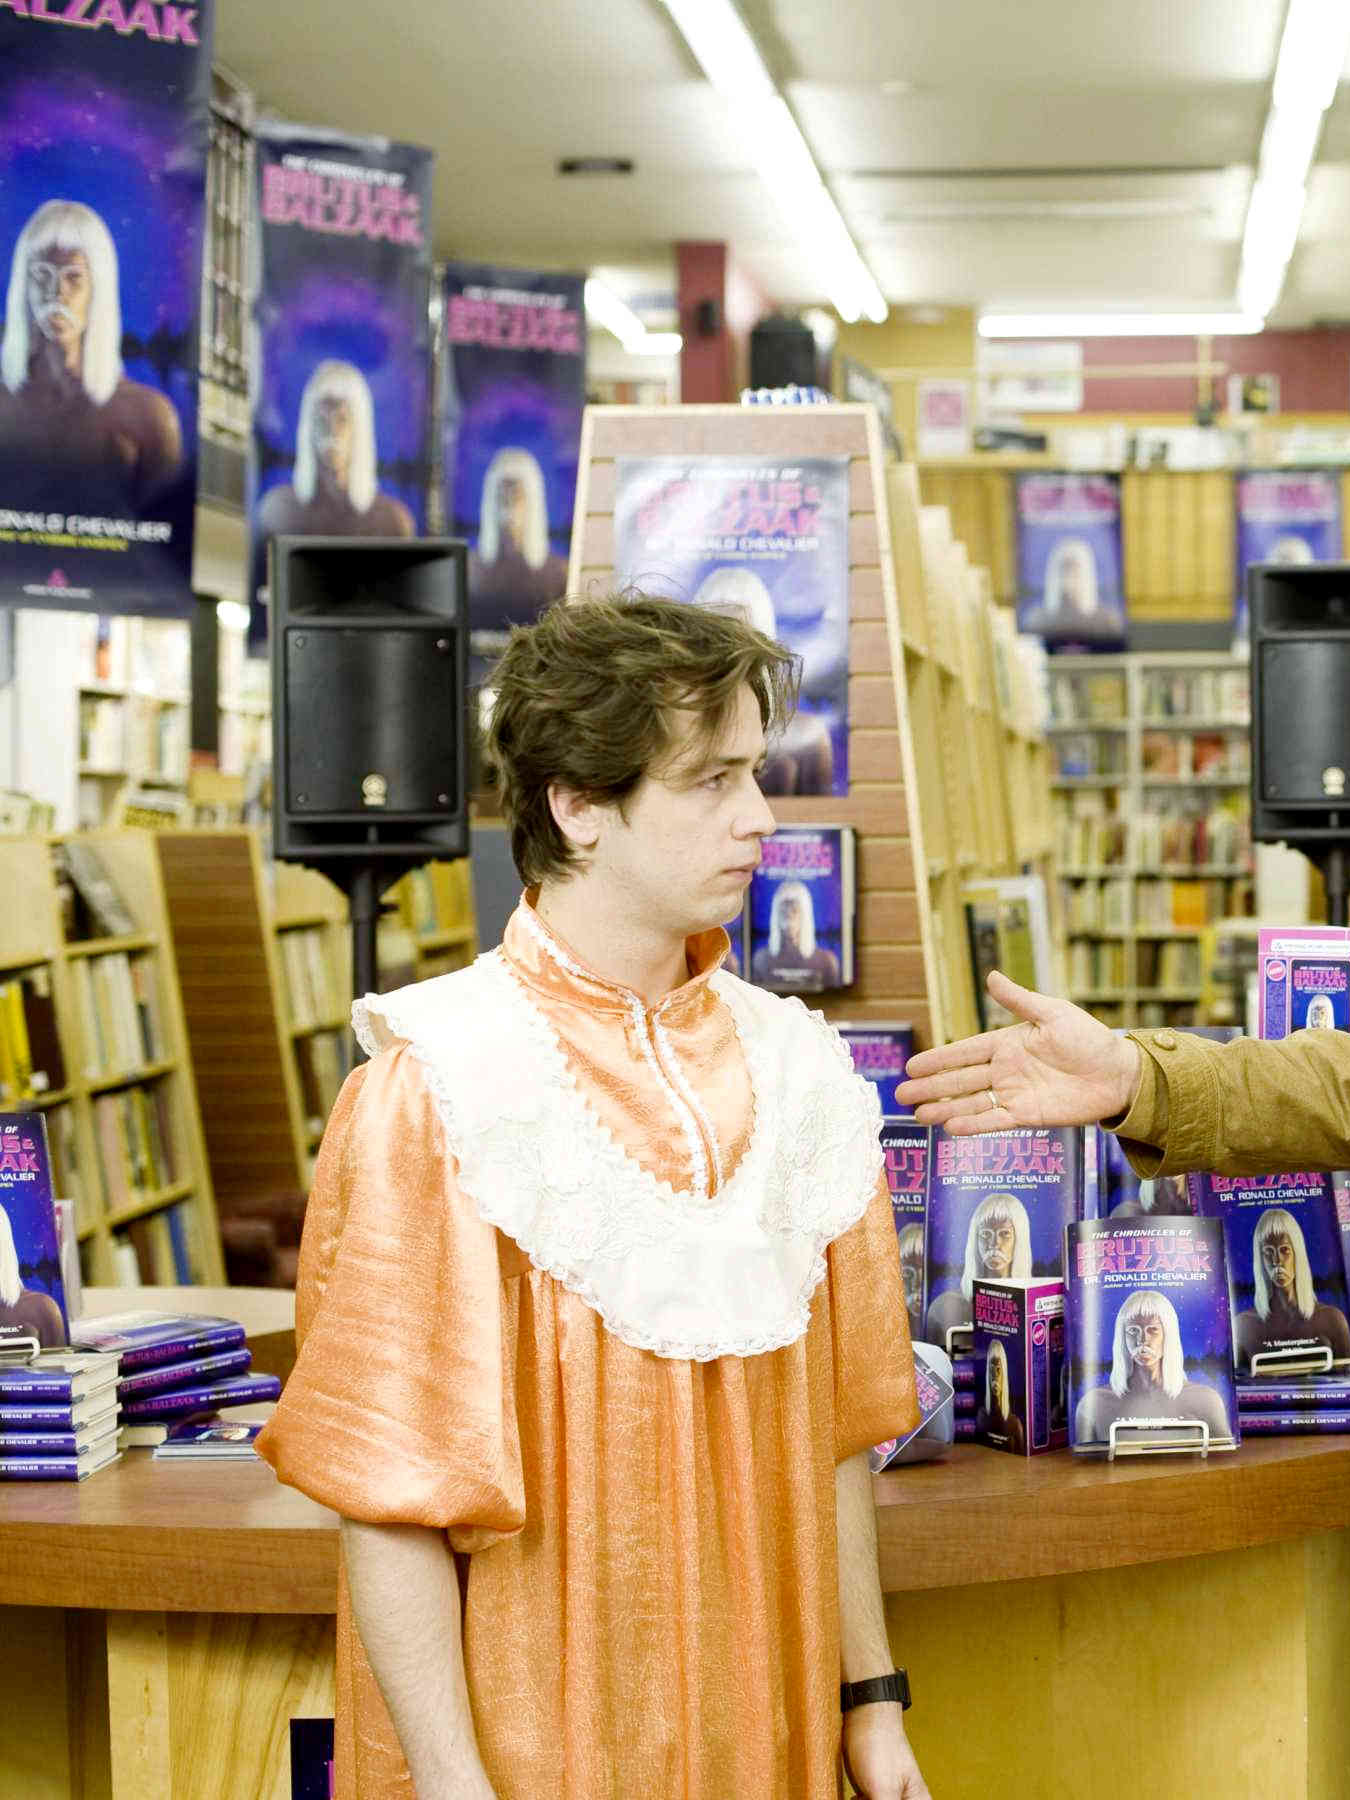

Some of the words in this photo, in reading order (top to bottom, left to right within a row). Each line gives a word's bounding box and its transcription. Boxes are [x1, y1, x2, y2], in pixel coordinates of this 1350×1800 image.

[5, 1126, 18, 1134] OF
[1036, 1130, 1050, 1138] OF
[937, 1139, 1049, 1159] BRUTUS
[937, 1157, 1067, 1176] BALZAAK
[961, 1176, 1004, 1185] RONALD
[1007, 1174, 1061, 1184] CHEVALIER
[1211, 1171, 1326, 1192] BALZAAK
[1219, 1193, 1236, 1201] DR.
[1238, 1190, 1275, 1200] RONALD
[1277, 1188, 1323, 1198] CHEVALIER
[1091, 1231, 1110, 1239] THE
[1113, 1229, 1176, 1238] CHRONICLES
[1179, 1229, 1193, 1238] OF
[1077, 1237, 1194, 1259] BRUTUS
[1077, 1254, 1213, 1277] BALZAAK
[1104, 1273, 1148, 1282] RONALD
[1151, 1272, 1207, 1281] CHEVALIER
